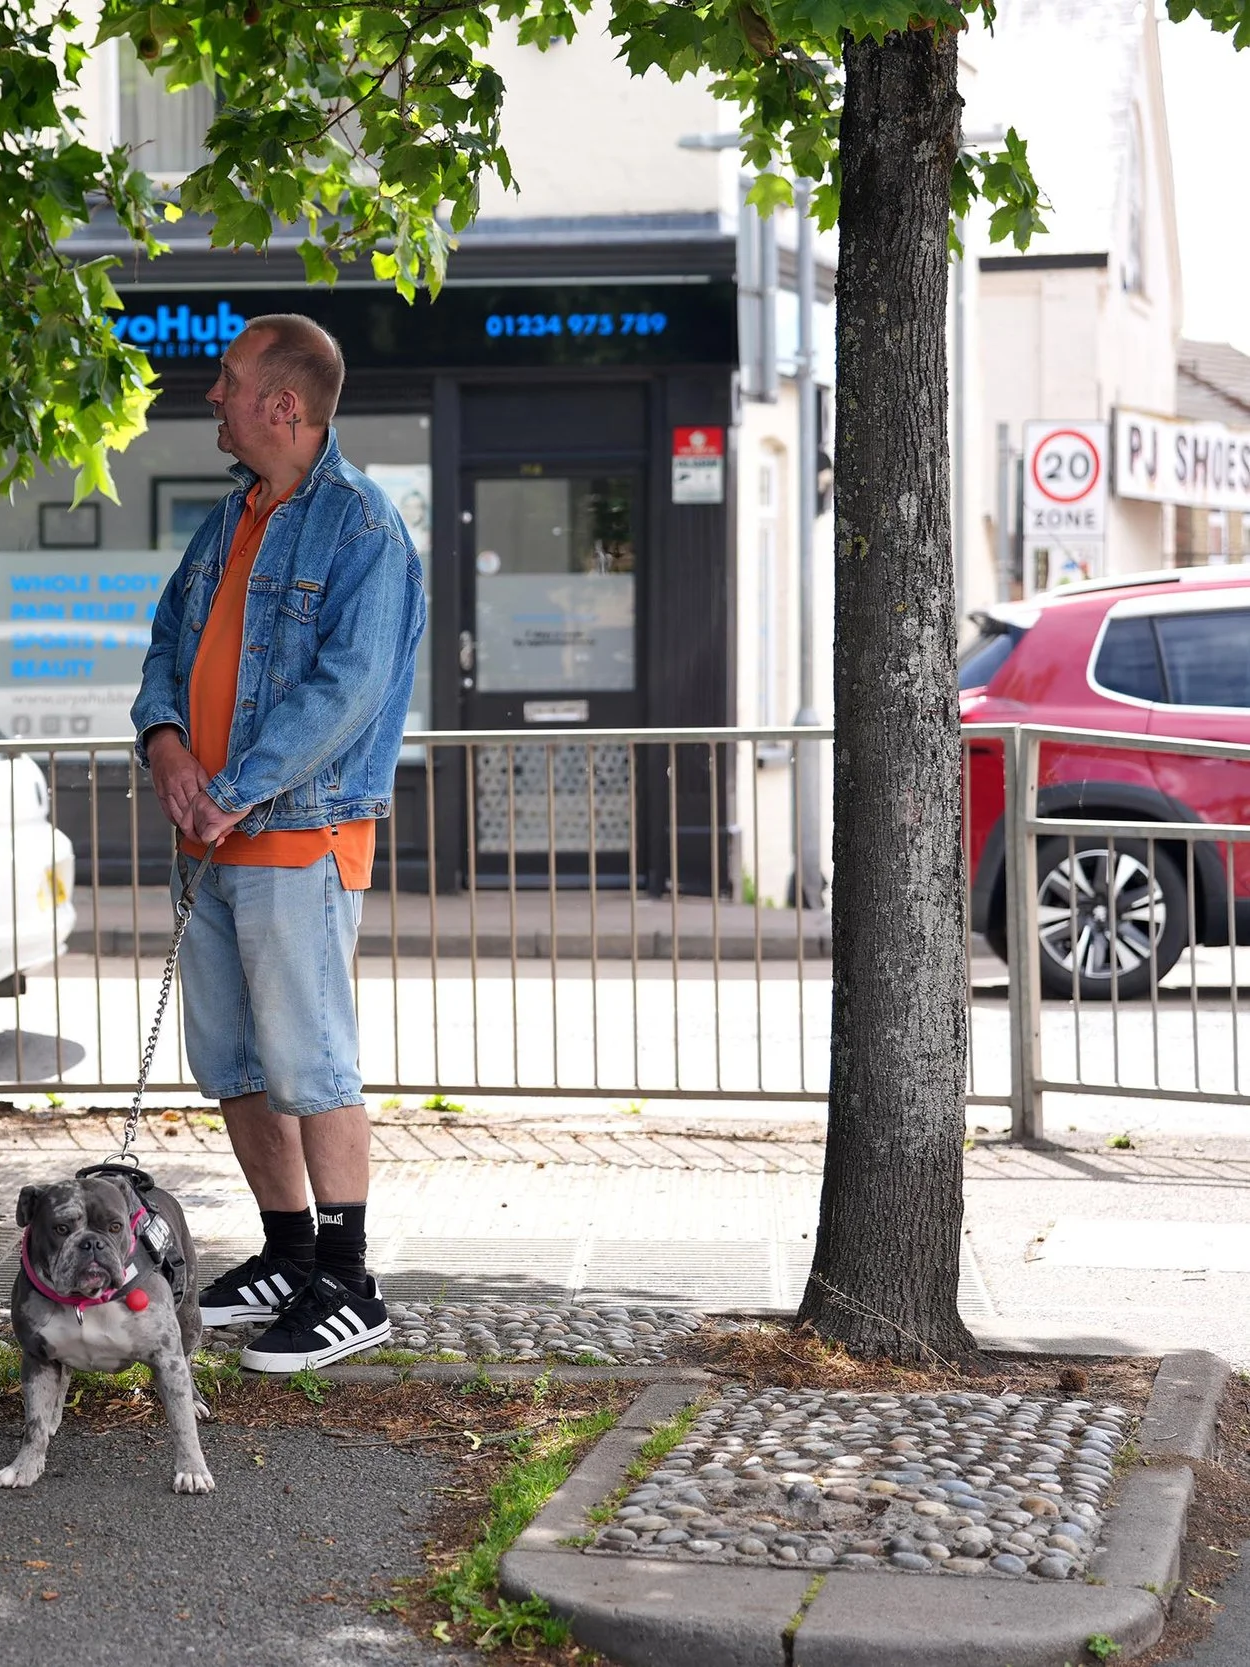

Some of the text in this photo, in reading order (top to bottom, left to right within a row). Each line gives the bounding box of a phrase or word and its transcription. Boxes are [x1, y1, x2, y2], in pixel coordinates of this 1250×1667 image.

[485, 312, 667, 337] 01234 975 789
[1044, 451, 1090, 481] 20
[1129, 424, 1250, 491] PJ SHOES
[1034, 508, 1096, 529] ZONE
[11, 574, 161, 593] WHOLE BODY
[11, 603, 65, 620] PAIN
[11, 659, 94, 677] BEAUTY
[319, 1212, 344, 1226] EVERLAST
[321, 1277, 337, 1289] adidas
